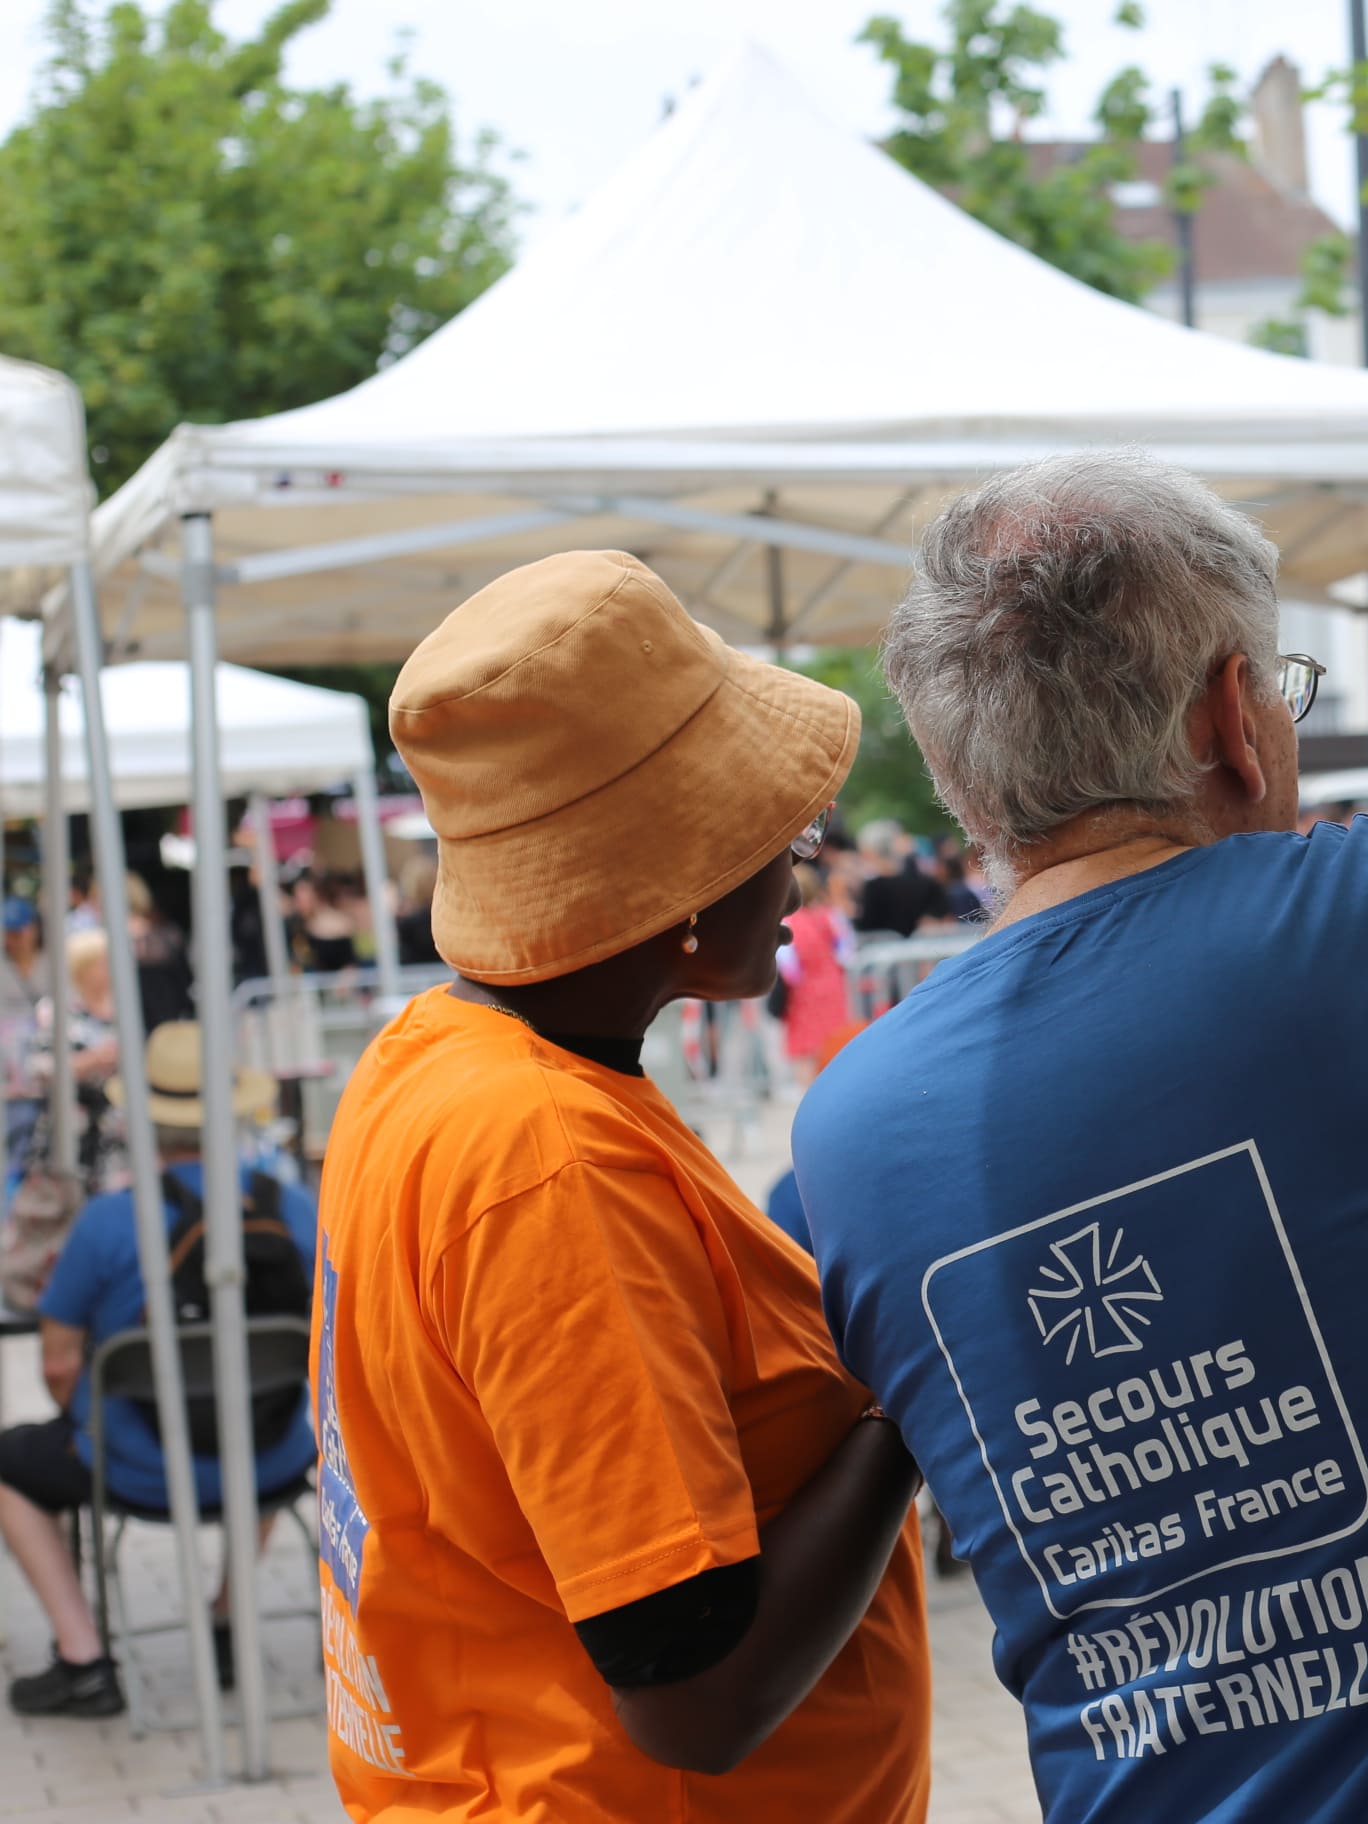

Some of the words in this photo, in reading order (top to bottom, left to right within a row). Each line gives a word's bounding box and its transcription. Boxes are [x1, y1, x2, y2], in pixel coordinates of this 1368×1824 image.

[1011, 1385, 1321, 1523] Catholique
[1014, 1340, 1256, 1459] Secours
[1043, 1513, 1185, 1587] Caritas
[1195, 1458, 1345, 1538] France
